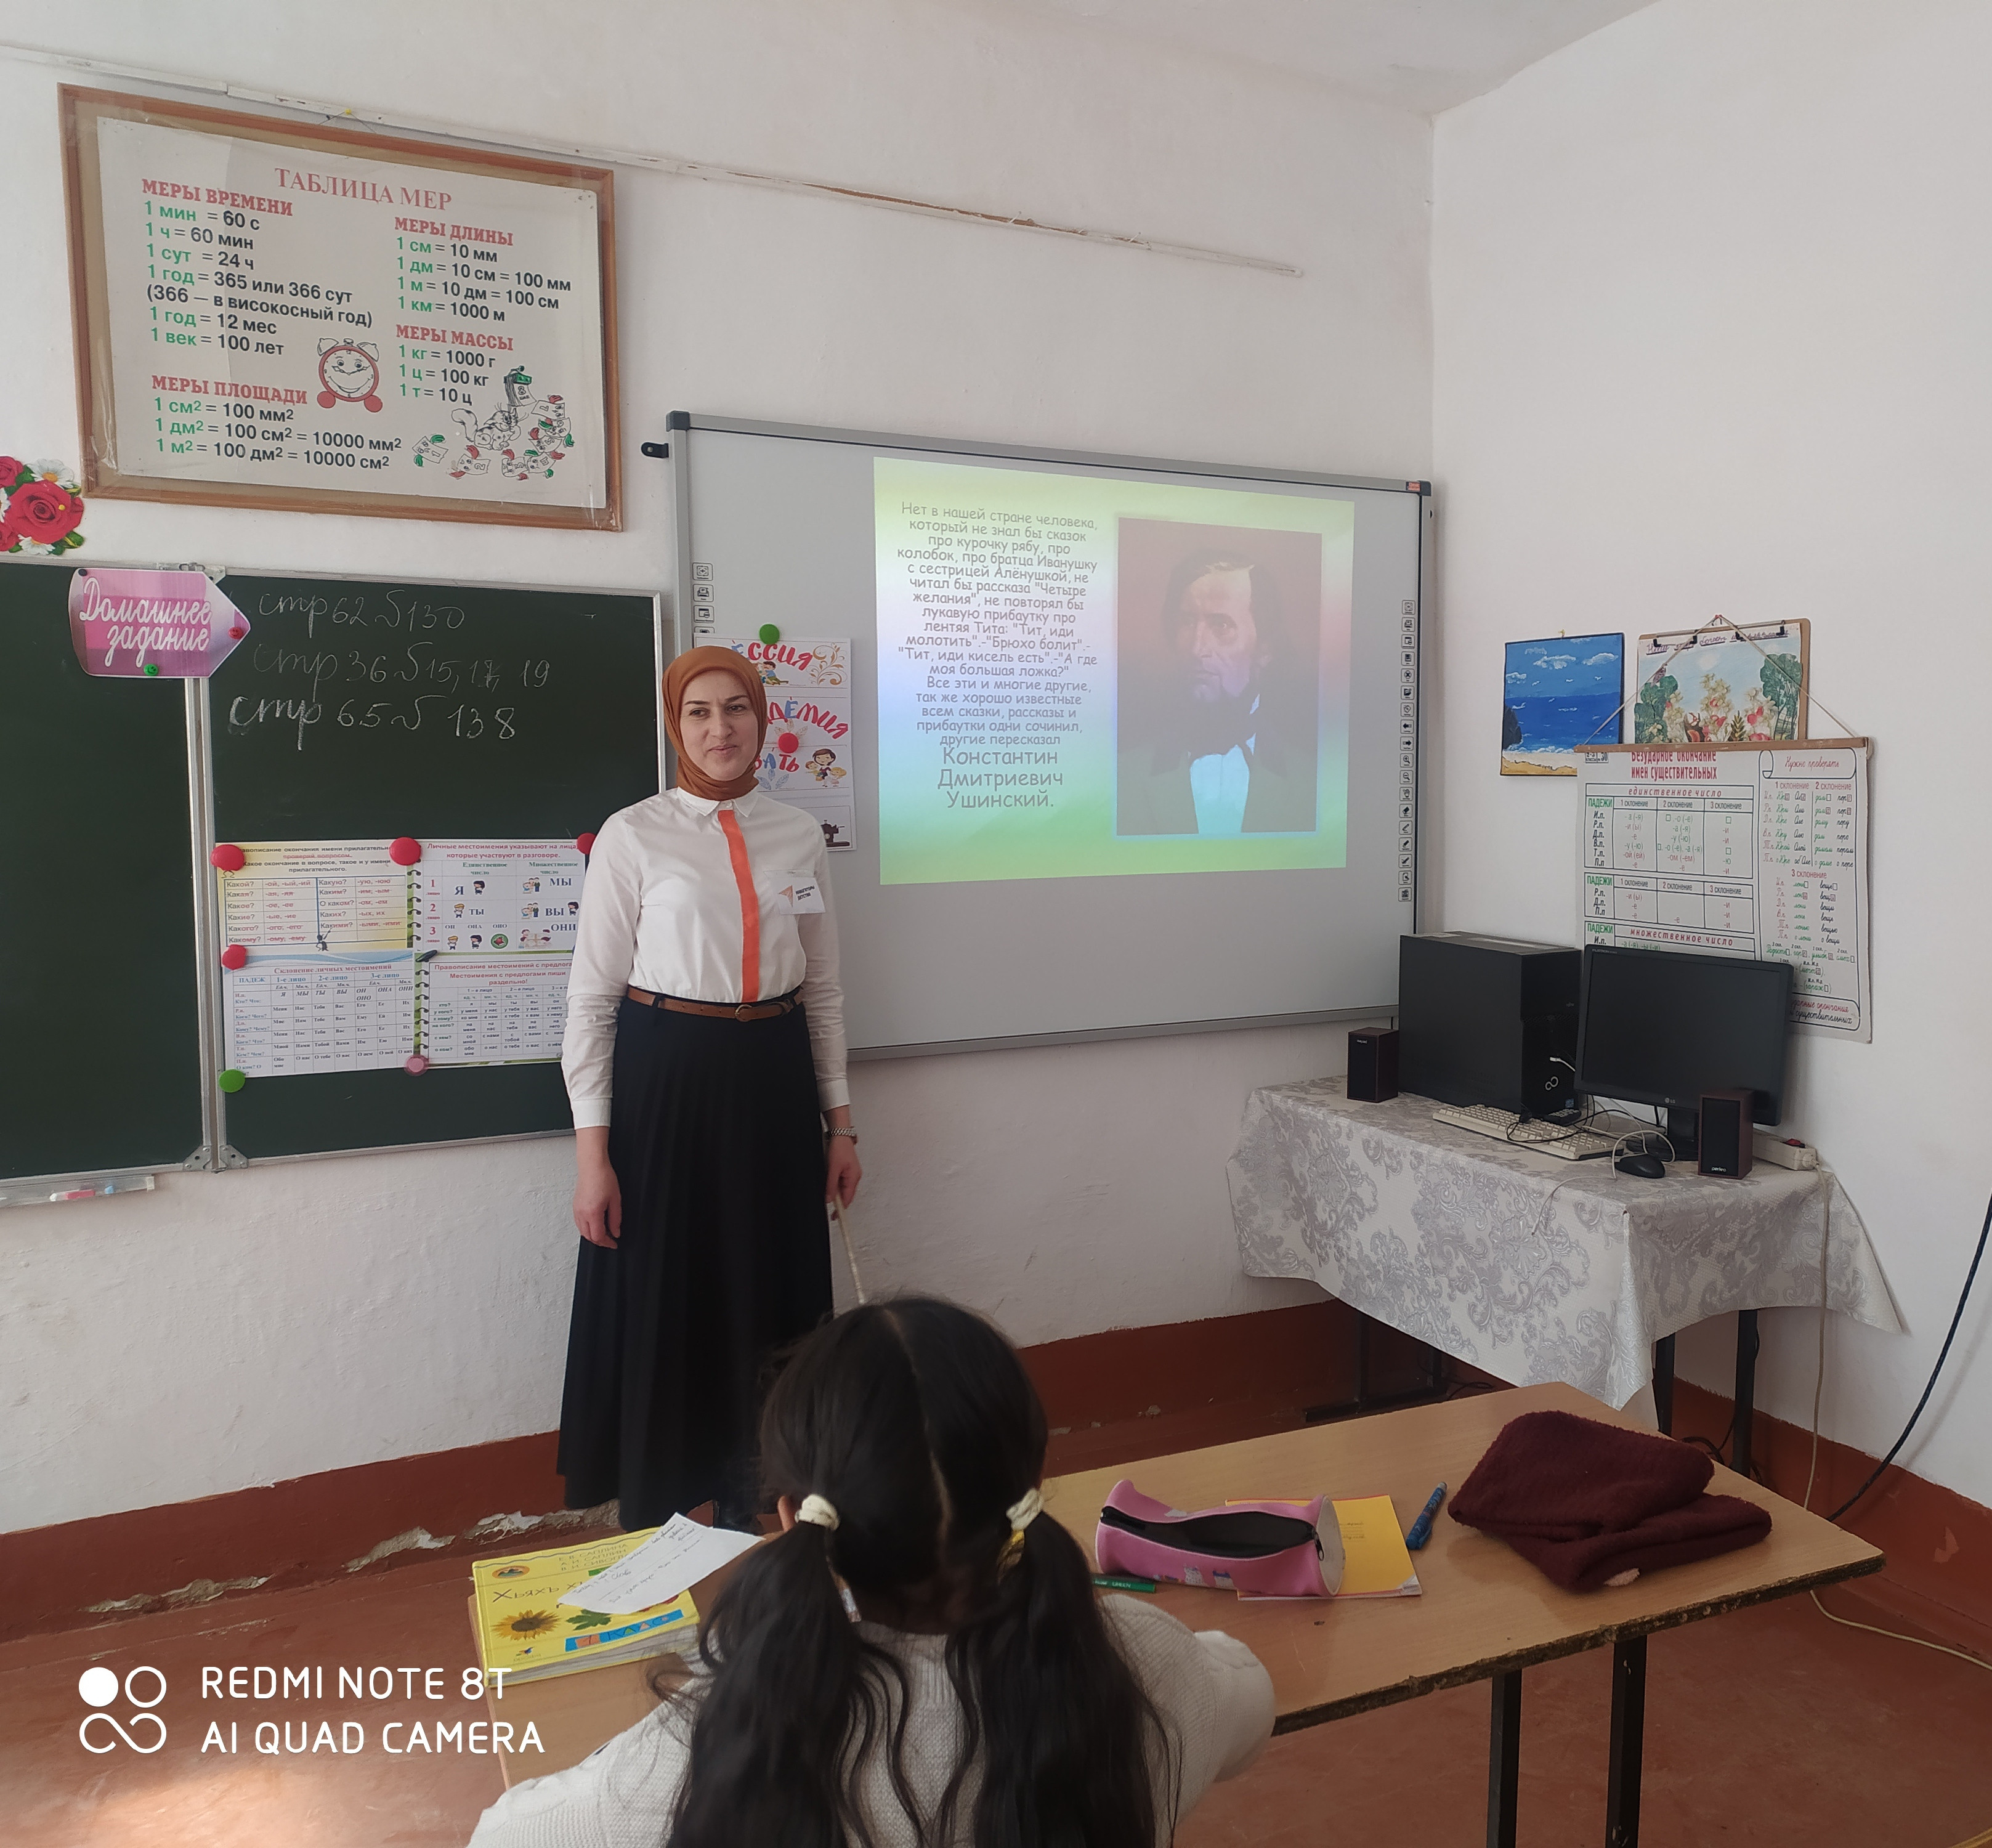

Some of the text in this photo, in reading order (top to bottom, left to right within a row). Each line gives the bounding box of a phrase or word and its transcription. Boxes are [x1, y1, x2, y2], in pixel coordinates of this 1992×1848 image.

[142, 178, 293, 216] МЕРЫ ВРЕМЕНИ
[275, 168, 451, 210] ТАБЛИЦА МЕР
[145, 200, 152, 215] 1
[159, 205, 196, 221] мин
[223, 211, 245, 227] 60
[250, 218, 260, 230] с
[395, 217, 514, 246] МЕРЫ ДЛИНЫ
[397, 237, 403, 249] 1
[410, 241, 431, 253] см
[450, 243, 469, 258] 10
[473, 249, 497, 262] мм
[148, 264, 155, 278] 1
[163, 268, 195, 285] год
[214, 271, 247, 290] 365
[252, 280, 284, 294] или
[289, 282, 320, 299] 366
[325, 289, 352, 306] сут
[147, 284, 188, 302] (366
[214, 295, 223, 307] в
[229, 297, 333, 321] високосный
[338, 311, 372, 328] год)
[396, 325, 514, 351] МЕРЫ МАССЫ
[399, 344, 405, 357] 1
[412, 349, 427, 360] кг
[447, 350, 484, 367] 1000
[489, 358, 495, 367] г
[152, 375, 307, 406] МЕРЫ ПЛОЩАДИ
[902, 501, 1098, 530] Нет в нашей стране человека,
[910, 519, 1087, 541] который не знал бы сказок
[908, 563, 1089, 584] с сестрицей Алёнушкой, не
[79, 577, 212, 625] Домашнее
[105, 625, 209, 668] задание
[927, 676, 1091, 694] Все эти и многие другие,
[916, 692, 1082, 707] так же хорошо известные
[922, 708, 1076, 720] всем сказки, рассказы и
[917, 719, 1082, 734] прибаутки одни сочинил,
[940, 735, 1061, 748] другие пересказал
[943, 747, 1058, 765] Константин
[937, 769, 1063, 791] Дмитриевич
[1631, 766, 1717, 782] имен существительных
[947, 789, 1054, 808] Ушинский.
[1629, 786, 1692, 796] единственное
[1588, 798, 1612, 808] ПАДЕЖИ
[455, 886, 464, 895] Я
[546, 908, 564, 916] ВЫ
[1587, 923, 1613, 934] ПАДЕЖИ
[1630, 929, 1733, 946] множественное число
